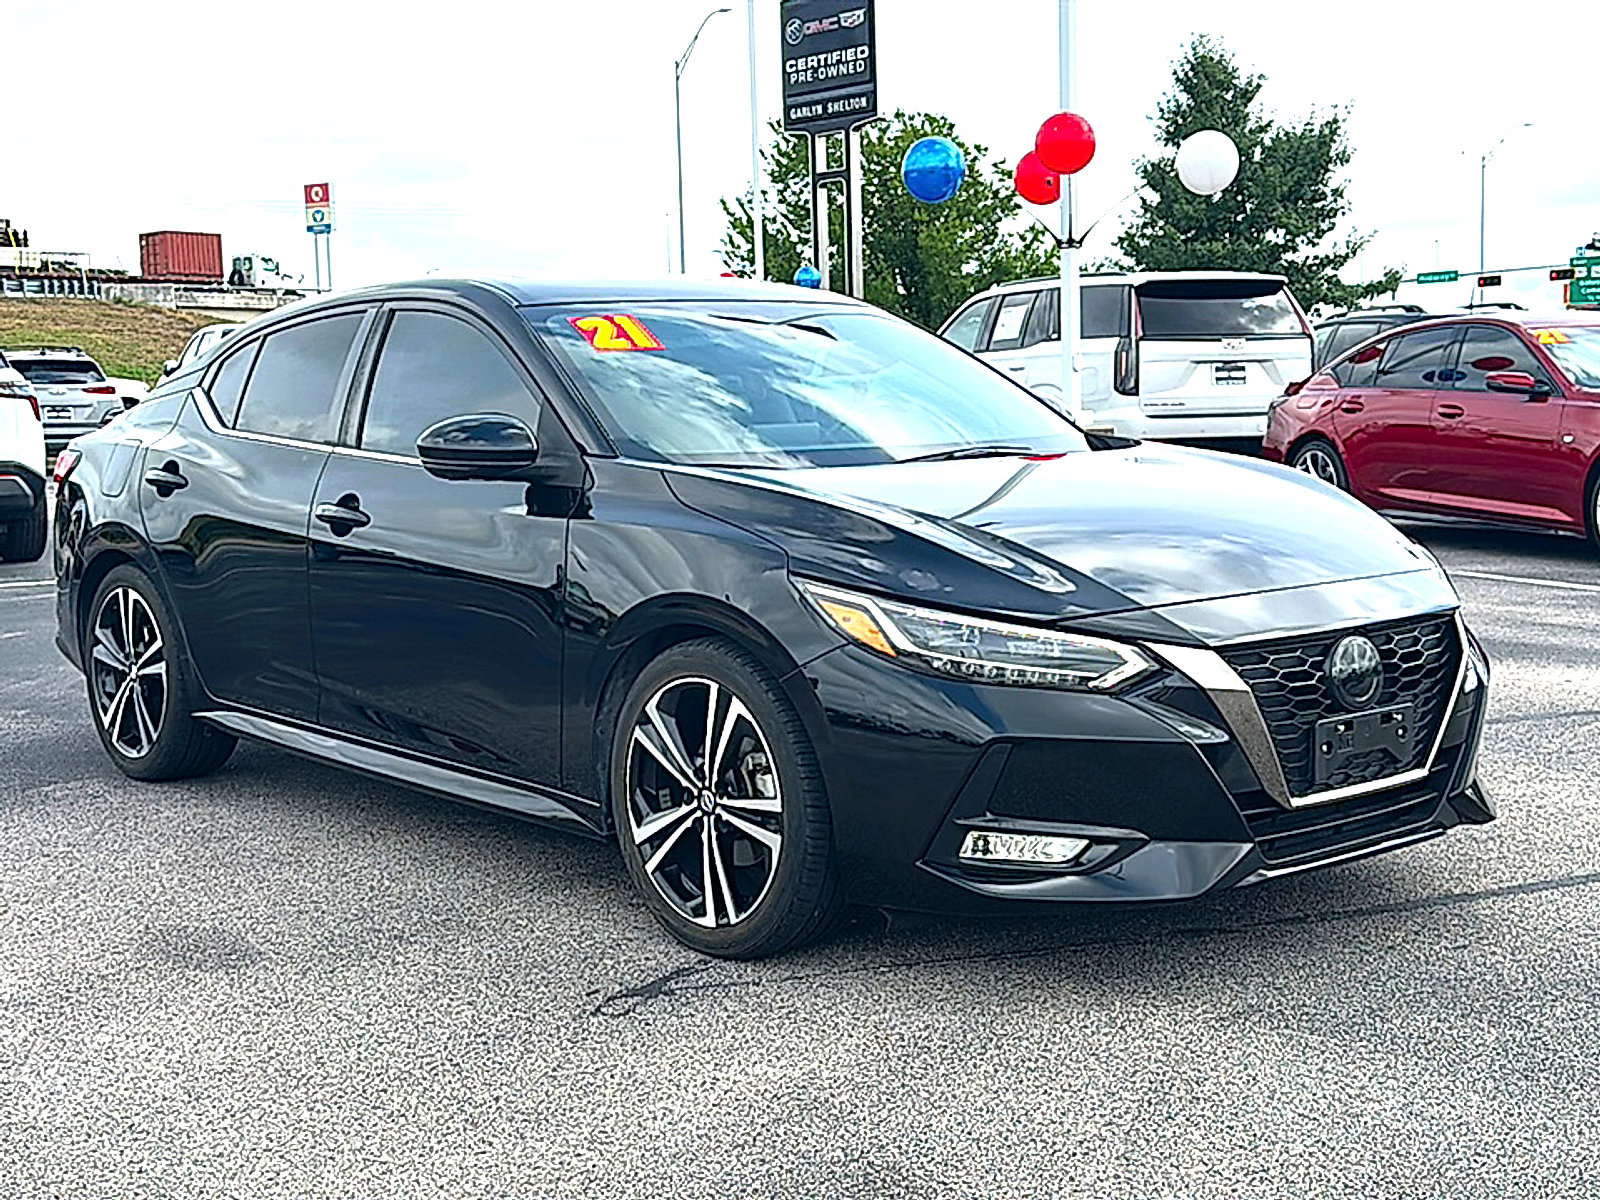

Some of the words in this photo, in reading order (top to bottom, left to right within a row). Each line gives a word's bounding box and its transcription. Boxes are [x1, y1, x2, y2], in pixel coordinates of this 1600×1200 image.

[786, 45, 869, 73] CERTIFIED
[790, 60, 865, 85] PRE-OWNED
[827, 97, 867, 113] SHELTON
[574, 315, 660, 349] 21
